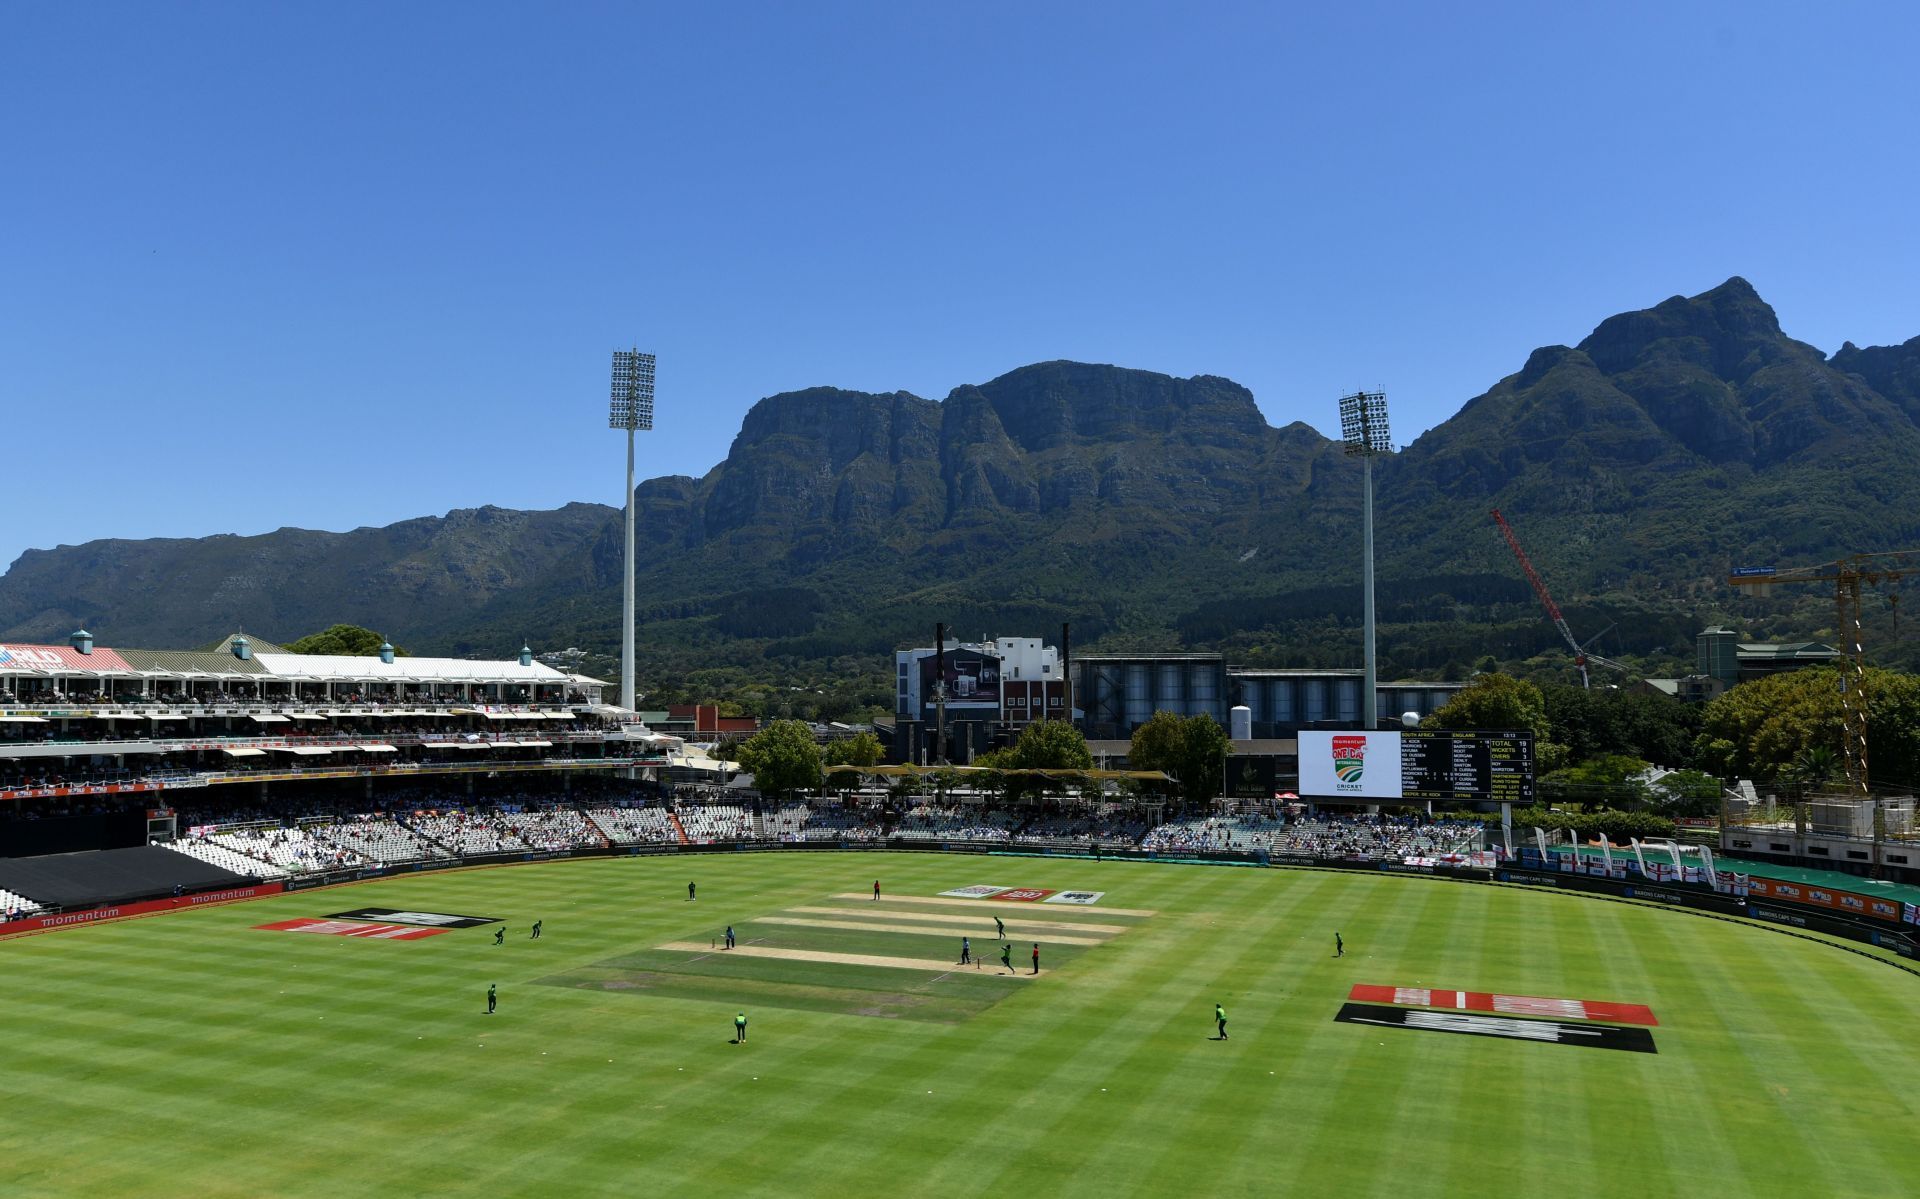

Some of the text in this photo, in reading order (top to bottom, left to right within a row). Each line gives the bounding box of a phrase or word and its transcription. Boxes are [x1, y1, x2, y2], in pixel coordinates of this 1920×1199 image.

[1332, 747, 1364, 760] ONE DAY
[191, 887, 255, 904] momentum
[1776, 883, 1800, 896] WORLD
[1808, 889, 1832, 901] WORLD
[1840, 895, 1864, 908] WORLD
[1871, 902, 1896, 914] WORLD
[41, 907, 119, 927] momentum
